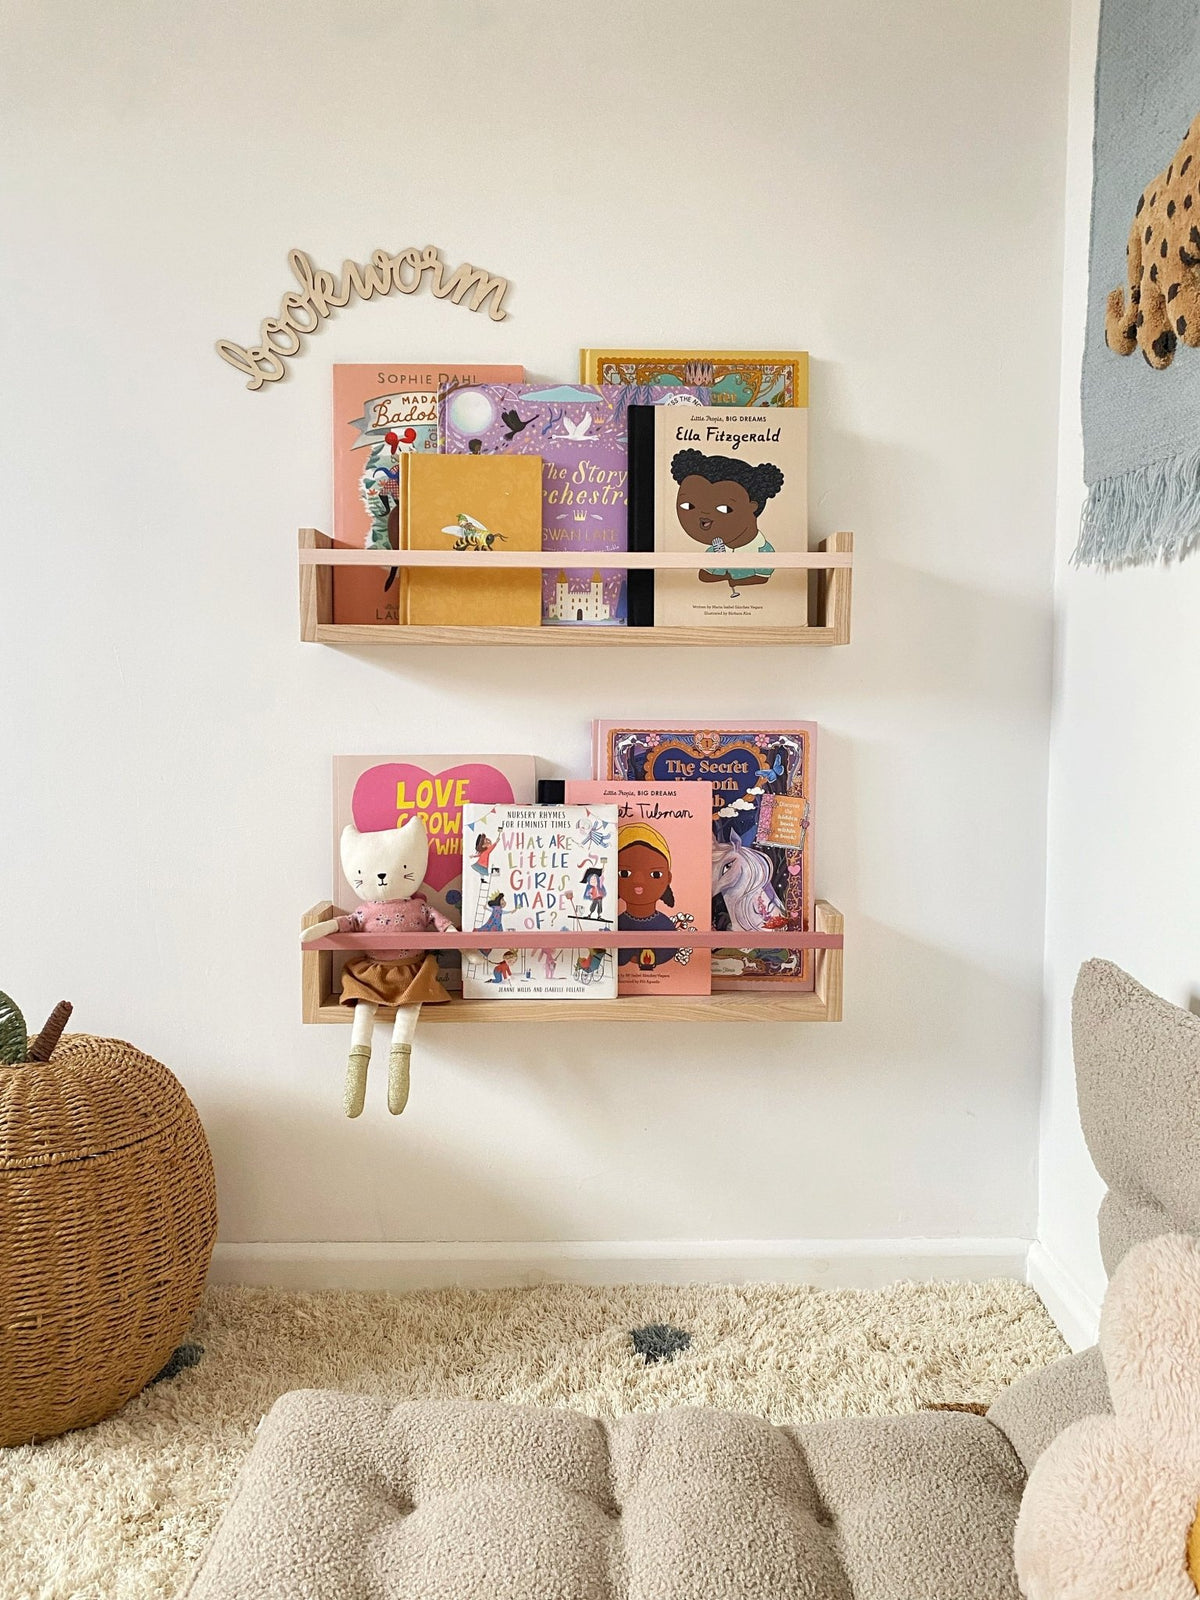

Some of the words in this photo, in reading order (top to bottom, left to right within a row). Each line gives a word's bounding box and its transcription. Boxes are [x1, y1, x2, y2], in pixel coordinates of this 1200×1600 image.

[215, 244, 508, 391] bookworm
[377, 372, 432, 385] SOPHIE
[438, 373, 480, 385] DAHL
[676, 426, 702, 441] Ella
[572, 460, 628, 488] Story
[543, 527, 580, 541] SWAN
[585, 527, 619, 541] LAKE
[665, 760, 695, 776] The
[699, 760, 749, 774] Secret
[396, 779, 471, 809] LOVE
[507, 811, 536, 819] NURSERY
[539, 811, 566, 819] RHYMES
[636, 802, 693, 819] Tubman
[517, 821, 547, 829] FEMINIST
[551, 821, 571, 829] TIMES
[548, 834, 572, 851] ARE
